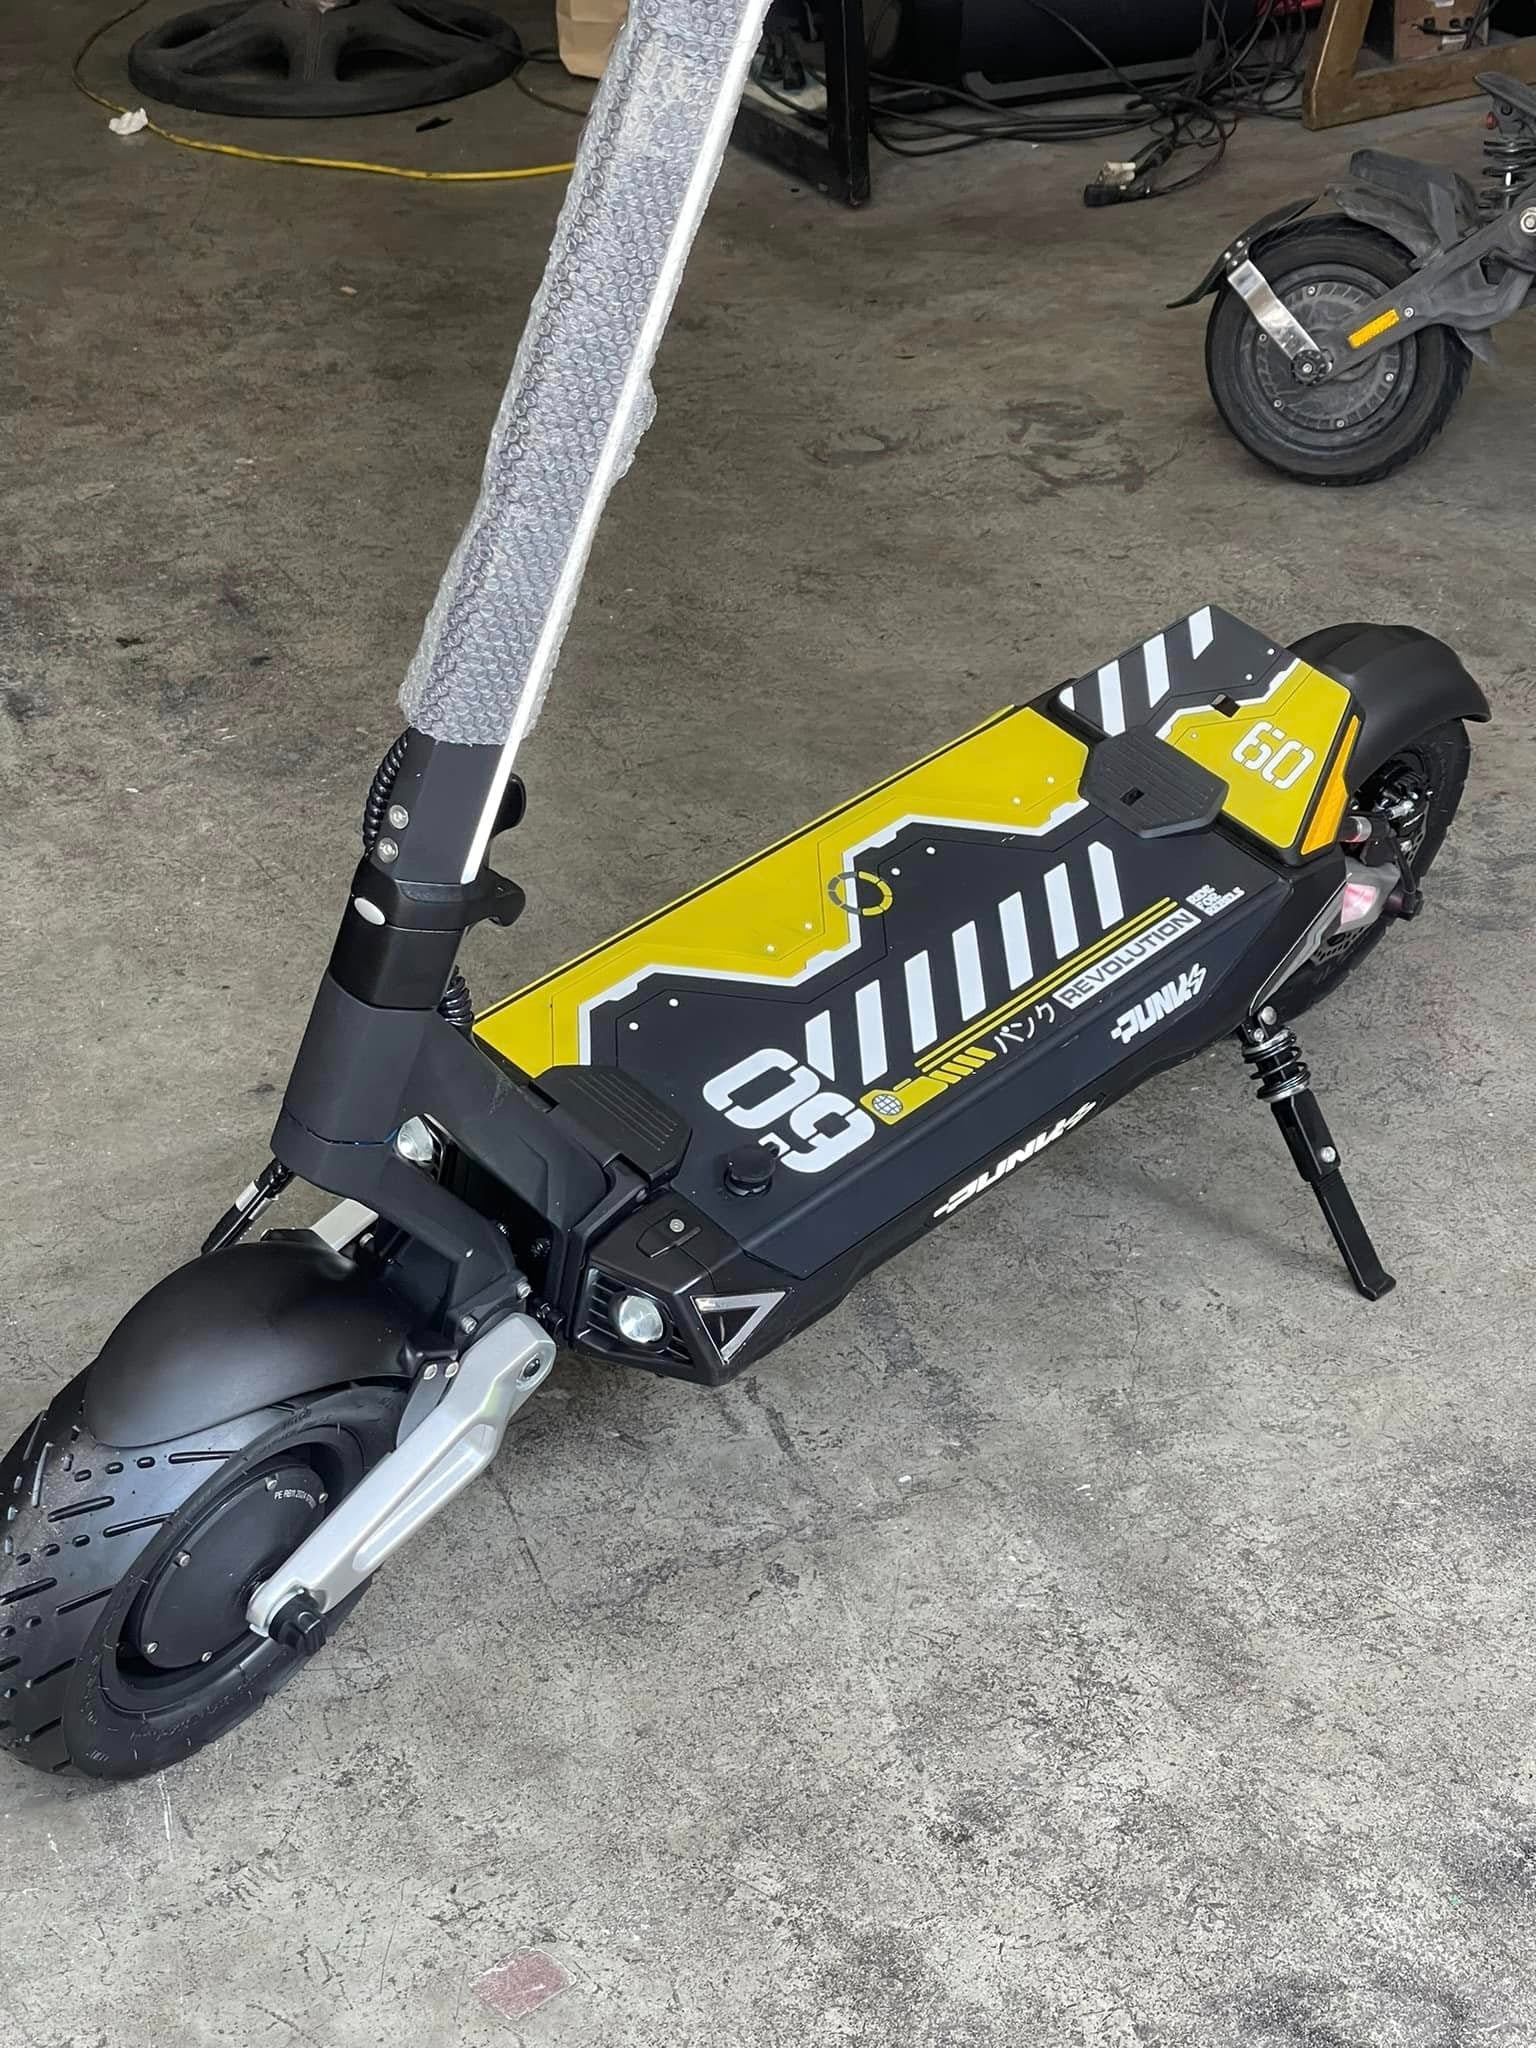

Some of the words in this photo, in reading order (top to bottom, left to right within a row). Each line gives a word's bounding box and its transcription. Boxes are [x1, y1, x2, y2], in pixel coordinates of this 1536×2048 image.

[1232, 720, 1315, 790] 60
[1057, 909, 1196, 1005] REVOLUTION
[993, 1002, 1056, 1054] パンク
